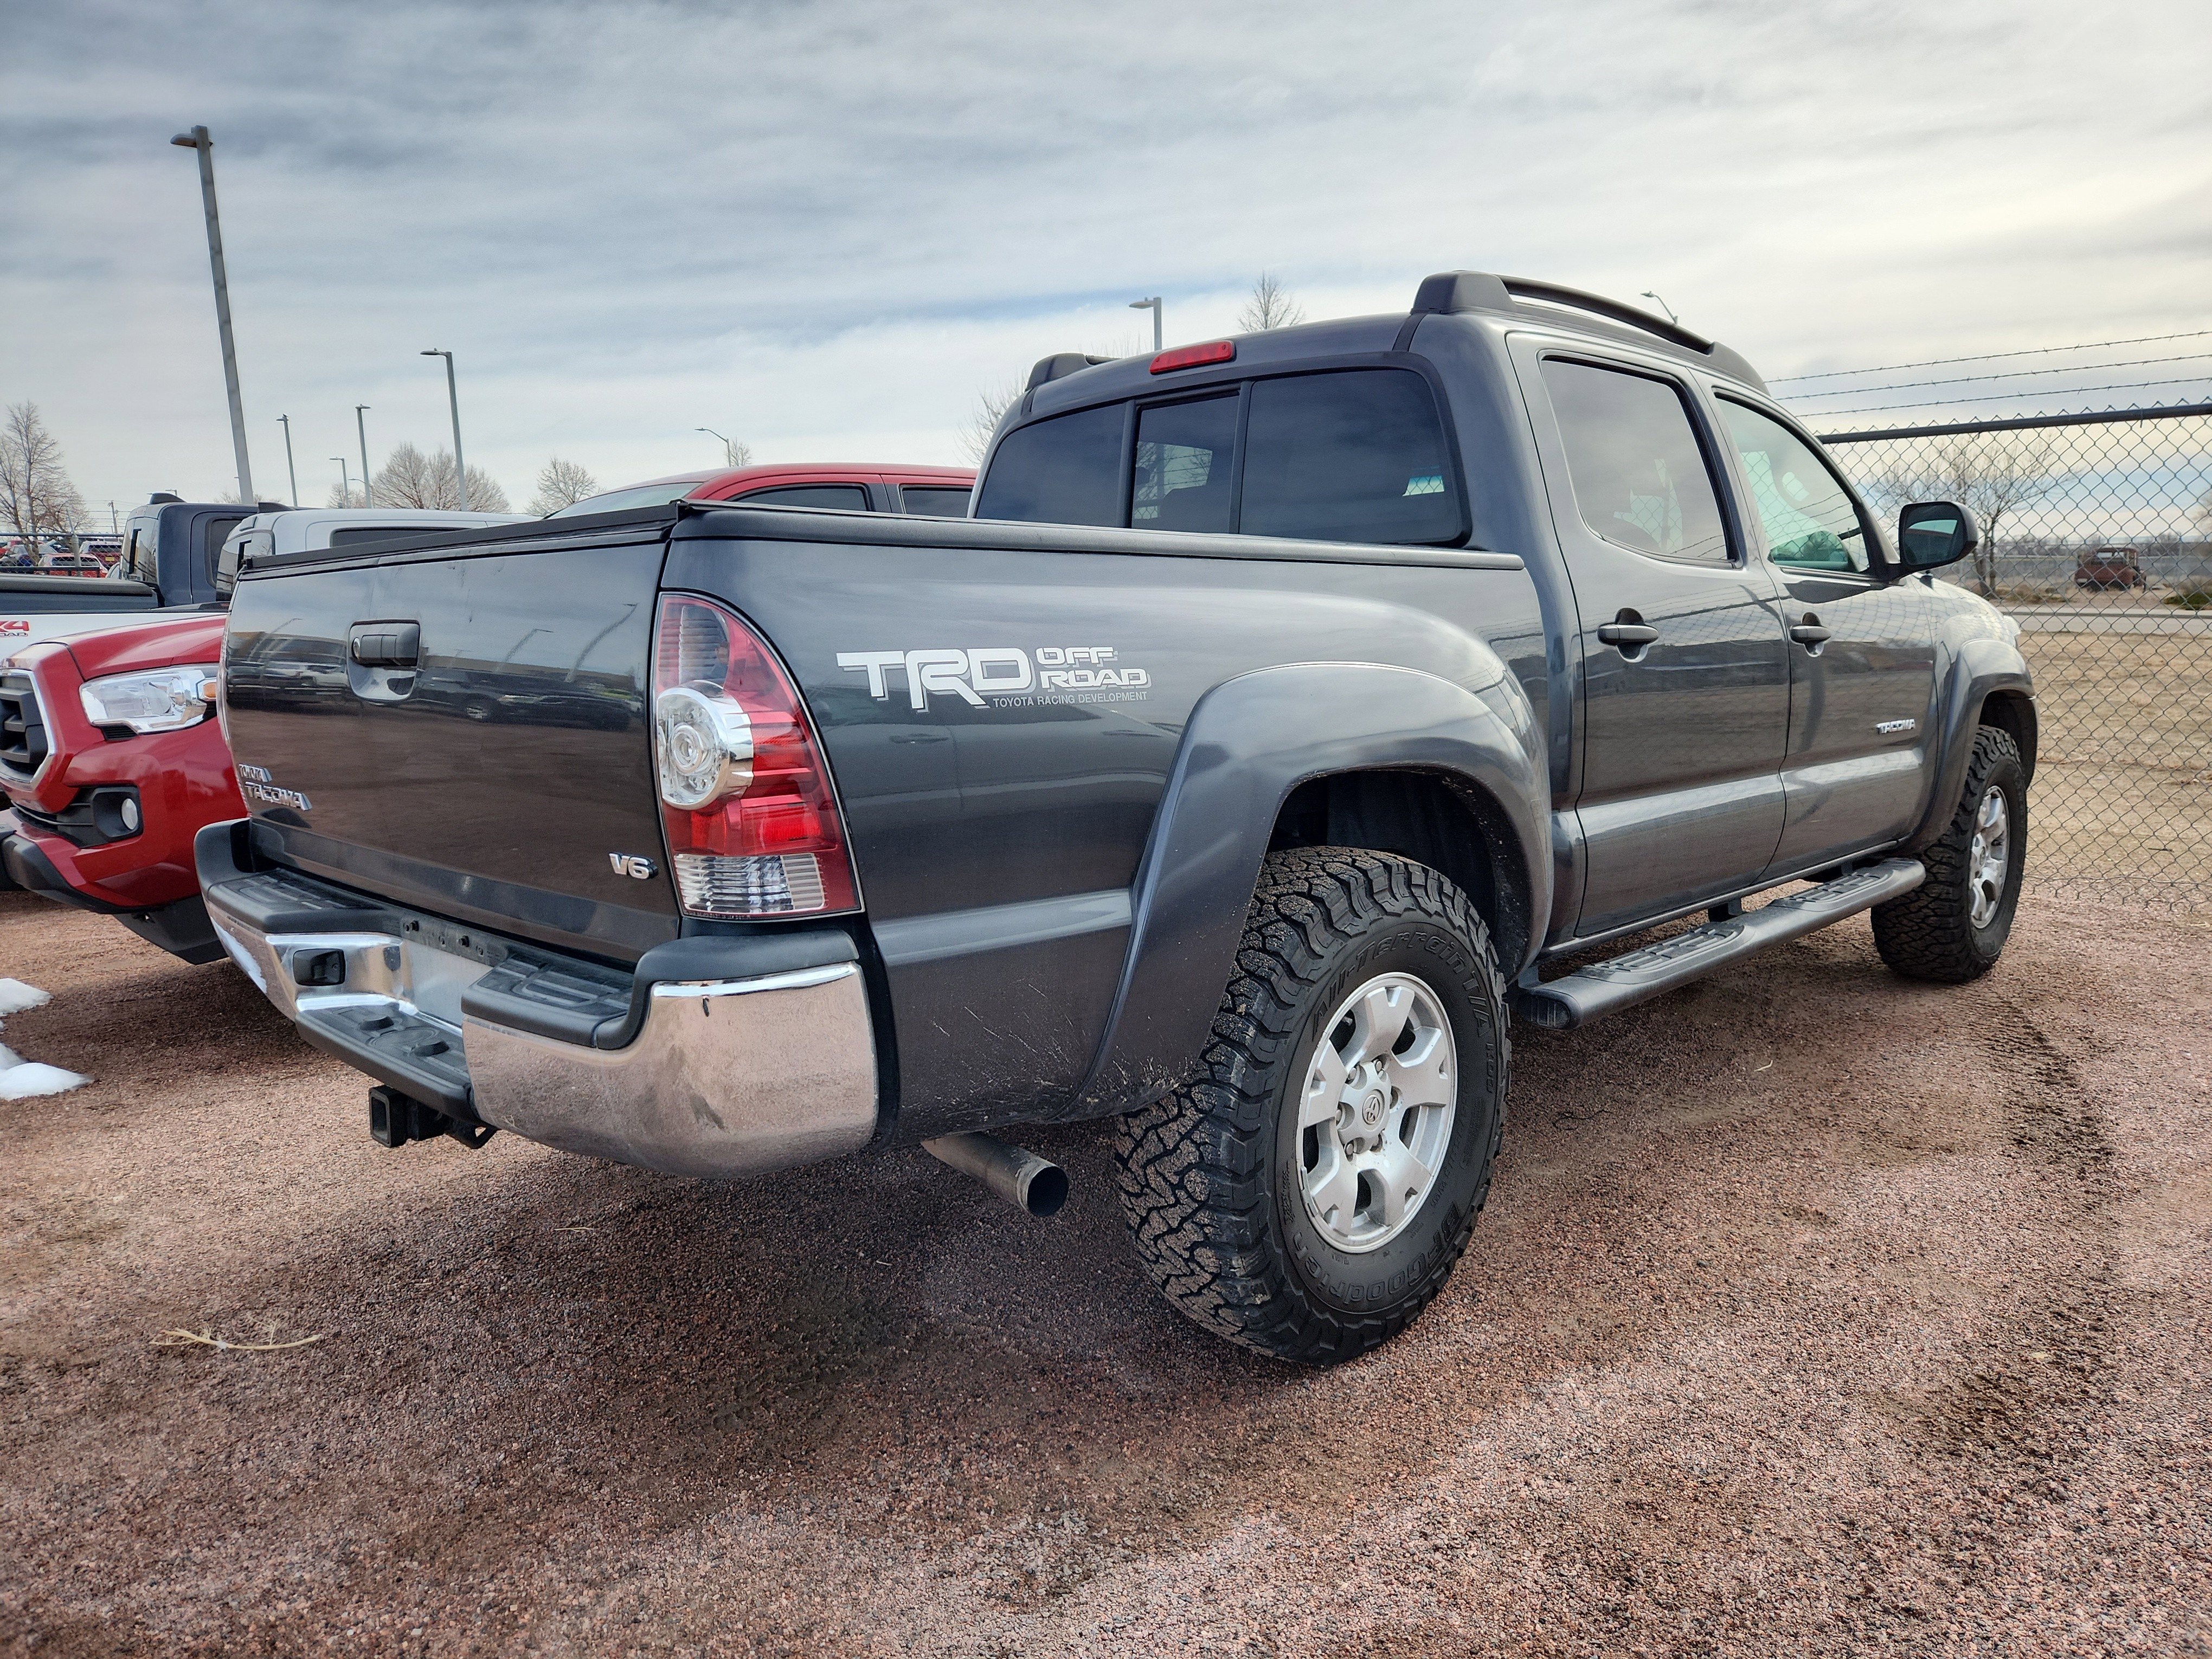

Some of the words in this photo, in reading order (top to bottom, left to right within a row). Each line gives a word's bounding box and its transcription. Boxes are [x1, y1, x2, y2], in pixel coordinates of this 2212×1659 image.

[1036, 647, 1118, 668] OFF
[836, 648, 1036, 712] TRD
[1039, 668, 1152, 692] ROAD
[993, 697, 1034, 708] TOYOTA
[1037, 694, 1075, 705] RACING
[1078, 691, 1147, 704] DEVELOPMENT
[1876, 718, 1915, 734] TACOMA
[239, 764, 272, 782] TOYOTA
[245, 782, 313, 811] TACOMA
[609, 852, 658, 879] V6
